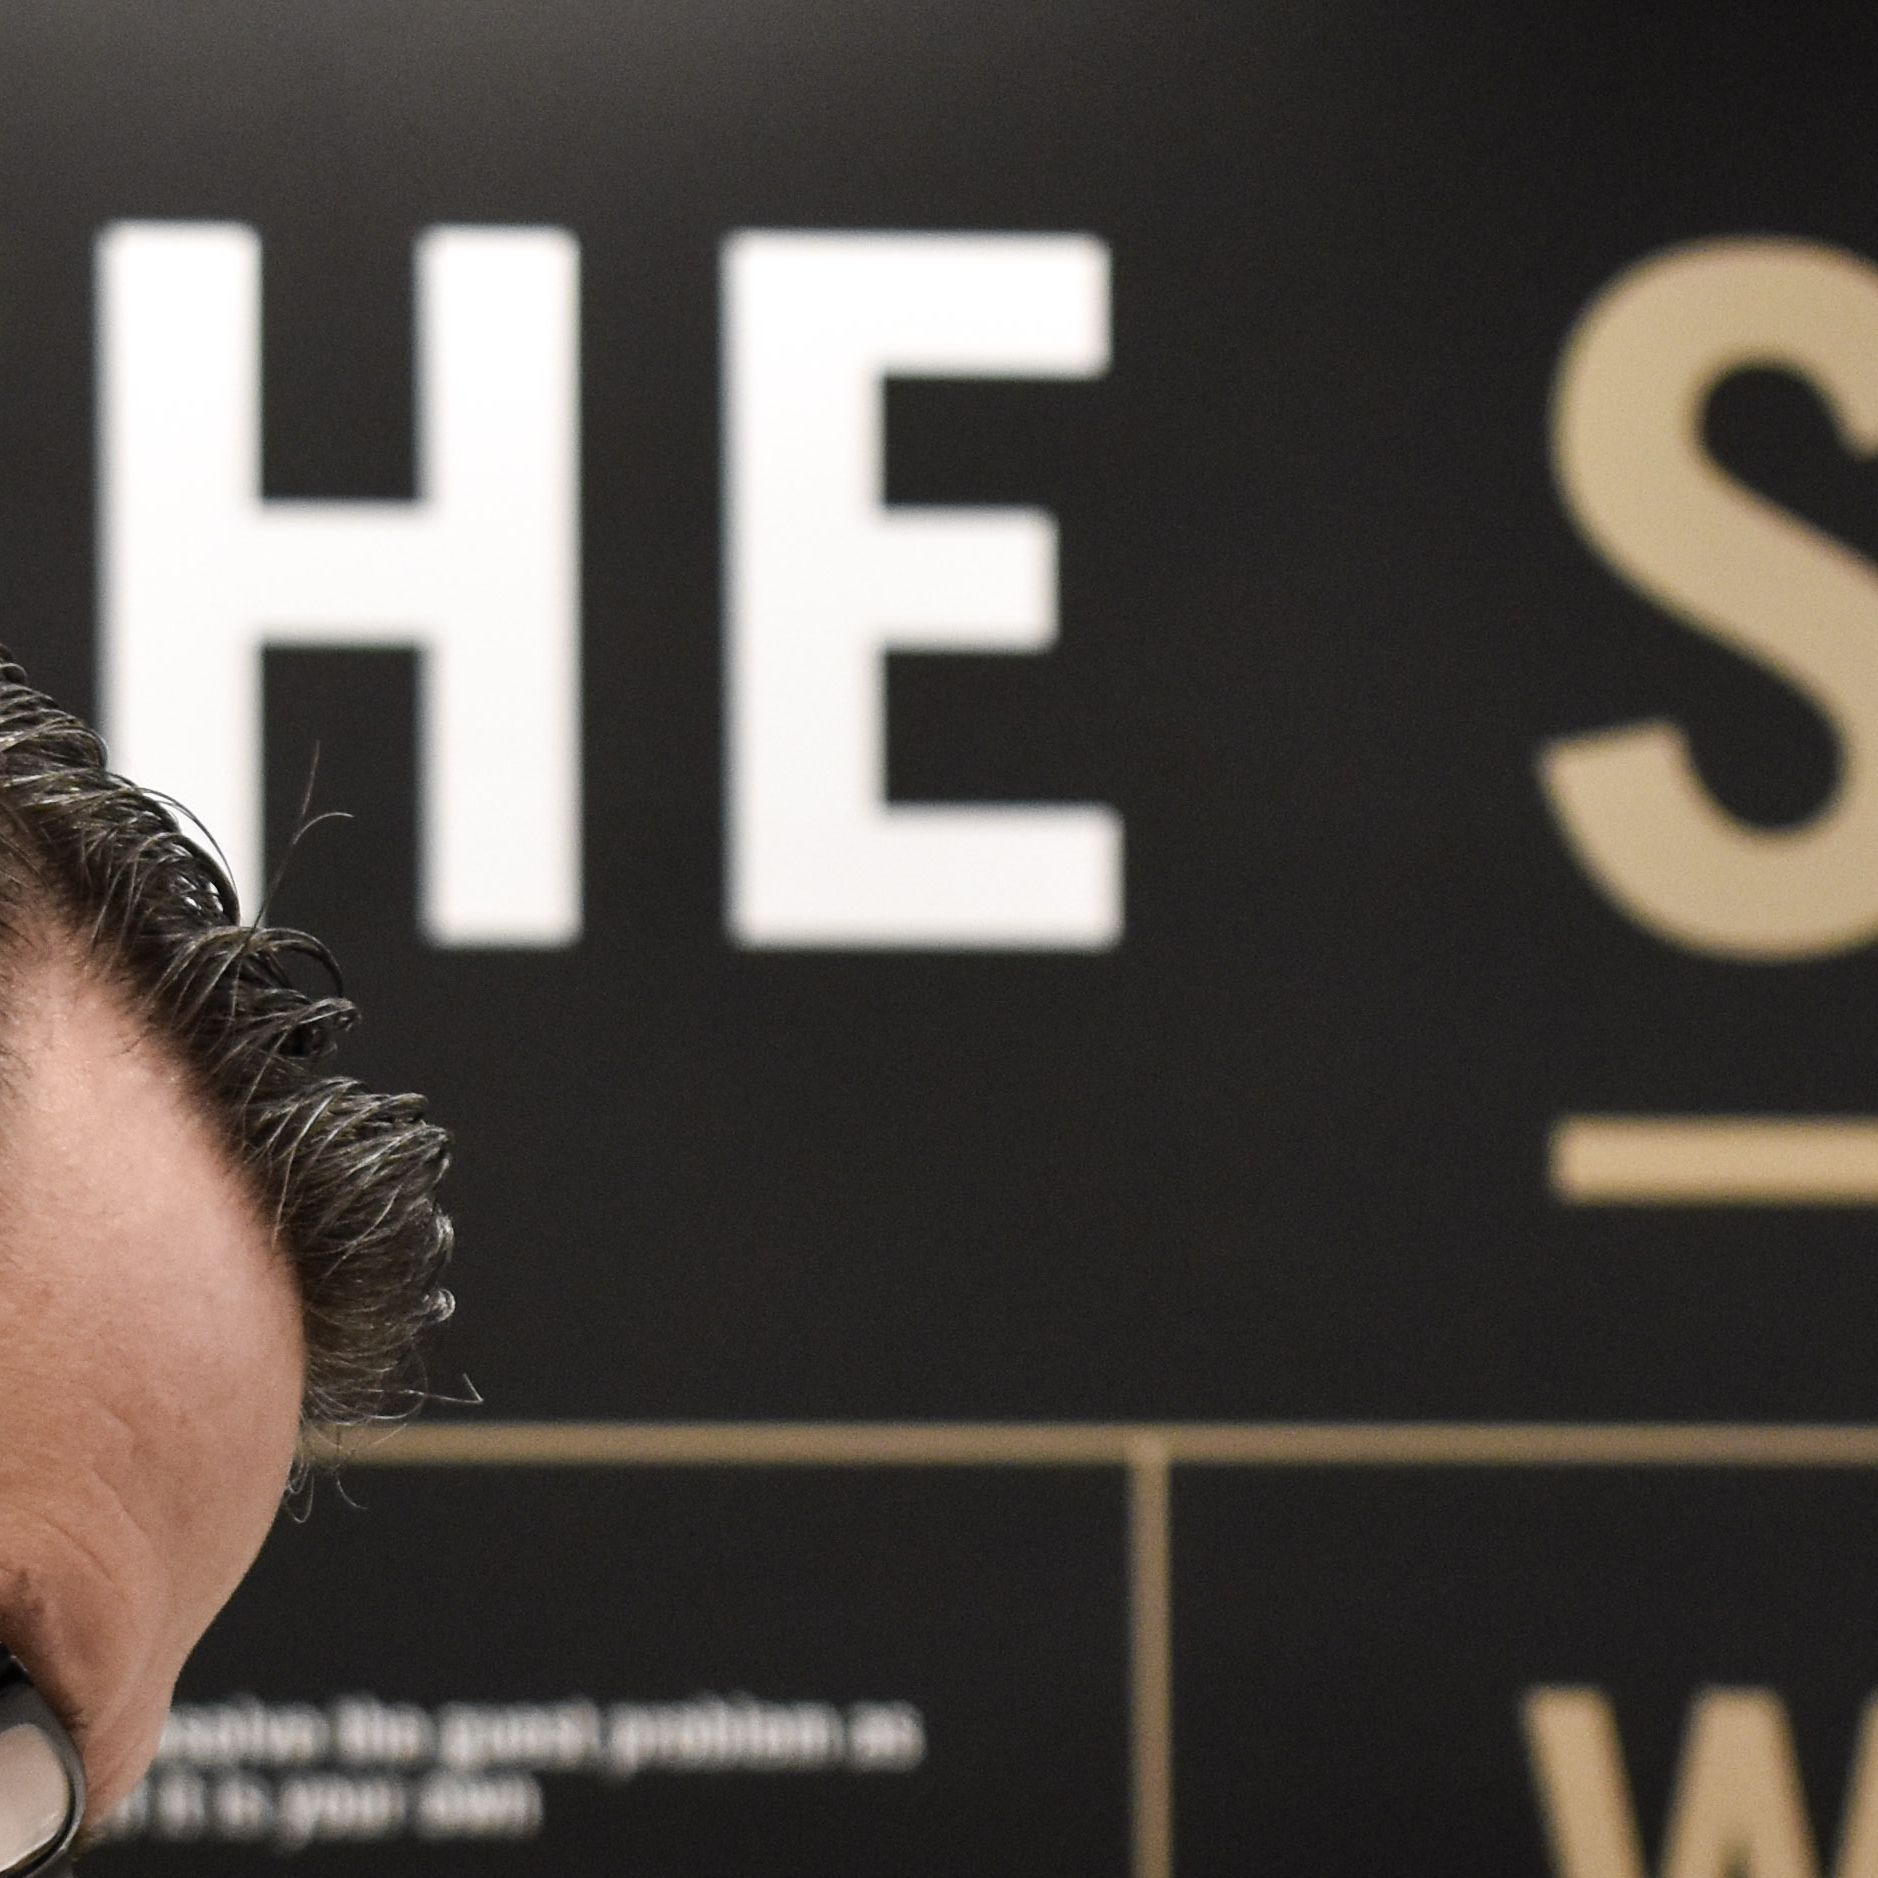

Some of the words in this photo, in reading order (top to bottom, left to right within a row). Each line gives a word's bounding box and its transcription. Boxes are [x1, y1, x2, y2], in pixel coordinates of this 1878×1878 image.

[334, 1698, 433, 1762] the
[439, 1698, 602, 1776] guest
[607, 1698, 845, 1776] problem
[850, 1706, 922, 1762] as
[277, 1778, 408, 1848] your
[414, 1778, 541, 1834] own
